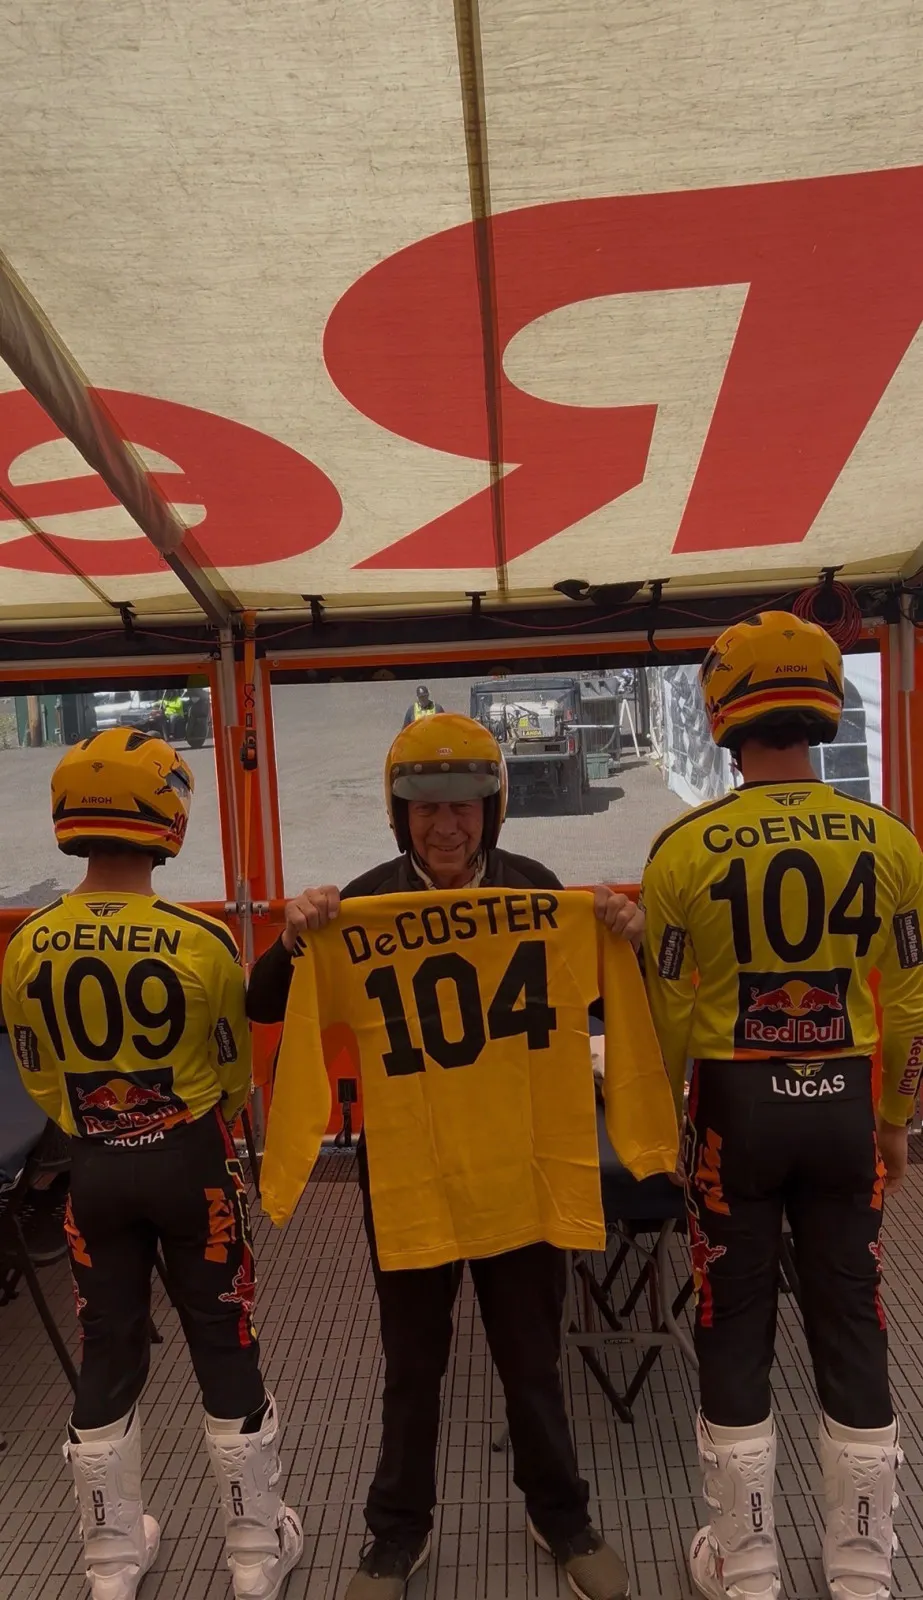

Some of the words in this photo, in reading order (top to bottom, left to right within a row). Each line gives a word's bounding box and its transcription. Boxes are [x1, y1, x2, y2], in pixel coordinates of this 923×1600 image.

[774, 665, 808, 673] AIROH
[81, 796, 112, 804] AIROH
[703, 814, 876, 853] CoENEN
[710, 848, 882, 964] 104
[32, 924, 181, 955] CoENEN
[341, 893, 558, 964] DeCOSTER
[27, 956, 186, 1062] 109
[365, 940, 557, 1077] 104
[745, 1018, 796, 1043] Red
[797, 1016, 845, 1043] Bull
[771, 1074, 846, 1097] LUCAS
[897, 1068, 920, 1096] Bull
[82, 1112, 132, 1135] Red
[92, 1490, 106, 1526] SIDI
[230, 1480, 244, 1516] SIDI
[751, 1491, 763, 1532] SIDI
[857, 1495, 870, 1536] SIDI
